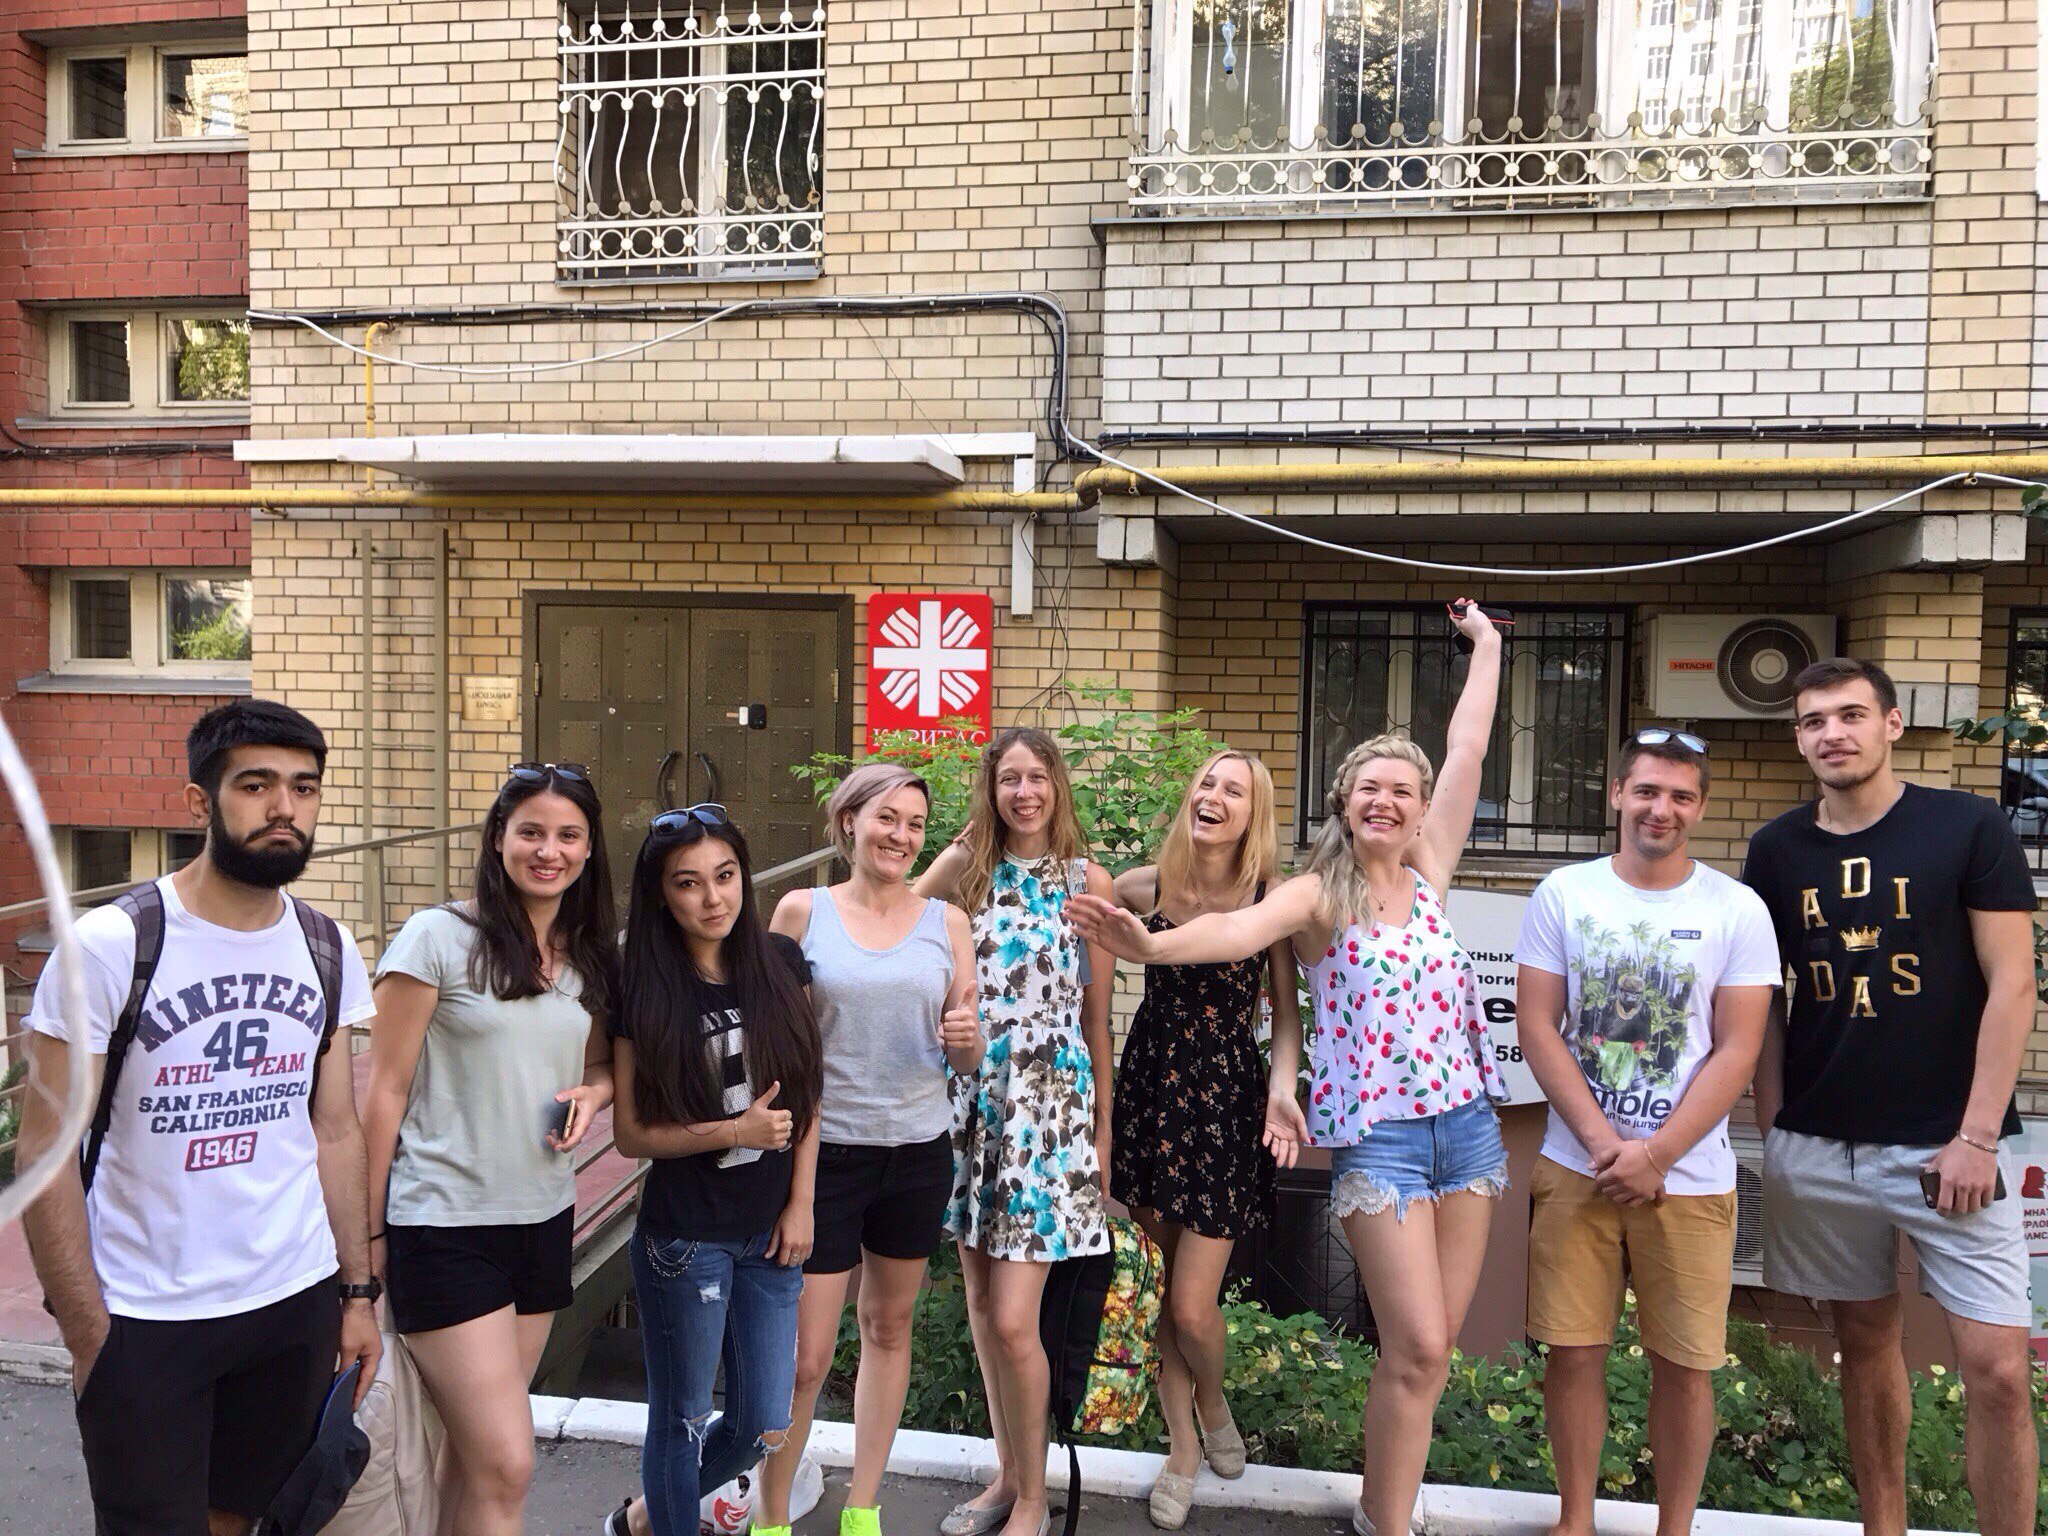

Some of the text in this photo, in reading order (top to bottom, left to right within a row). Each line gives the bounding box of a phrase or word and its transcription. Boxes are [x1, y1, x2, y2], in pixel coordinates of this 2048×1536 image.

[1477, 974, 1516, 986] логи
[203, 1018, 269, 1072] 46
[154, 1052, 307, 1086] ATHL TEAM
[138, 1080, 307, 1113] SAN FRANCISCO
[151, 1101, 290, 1133] CALIFORNIA
[190, 1136, 253, 1168] 1946
